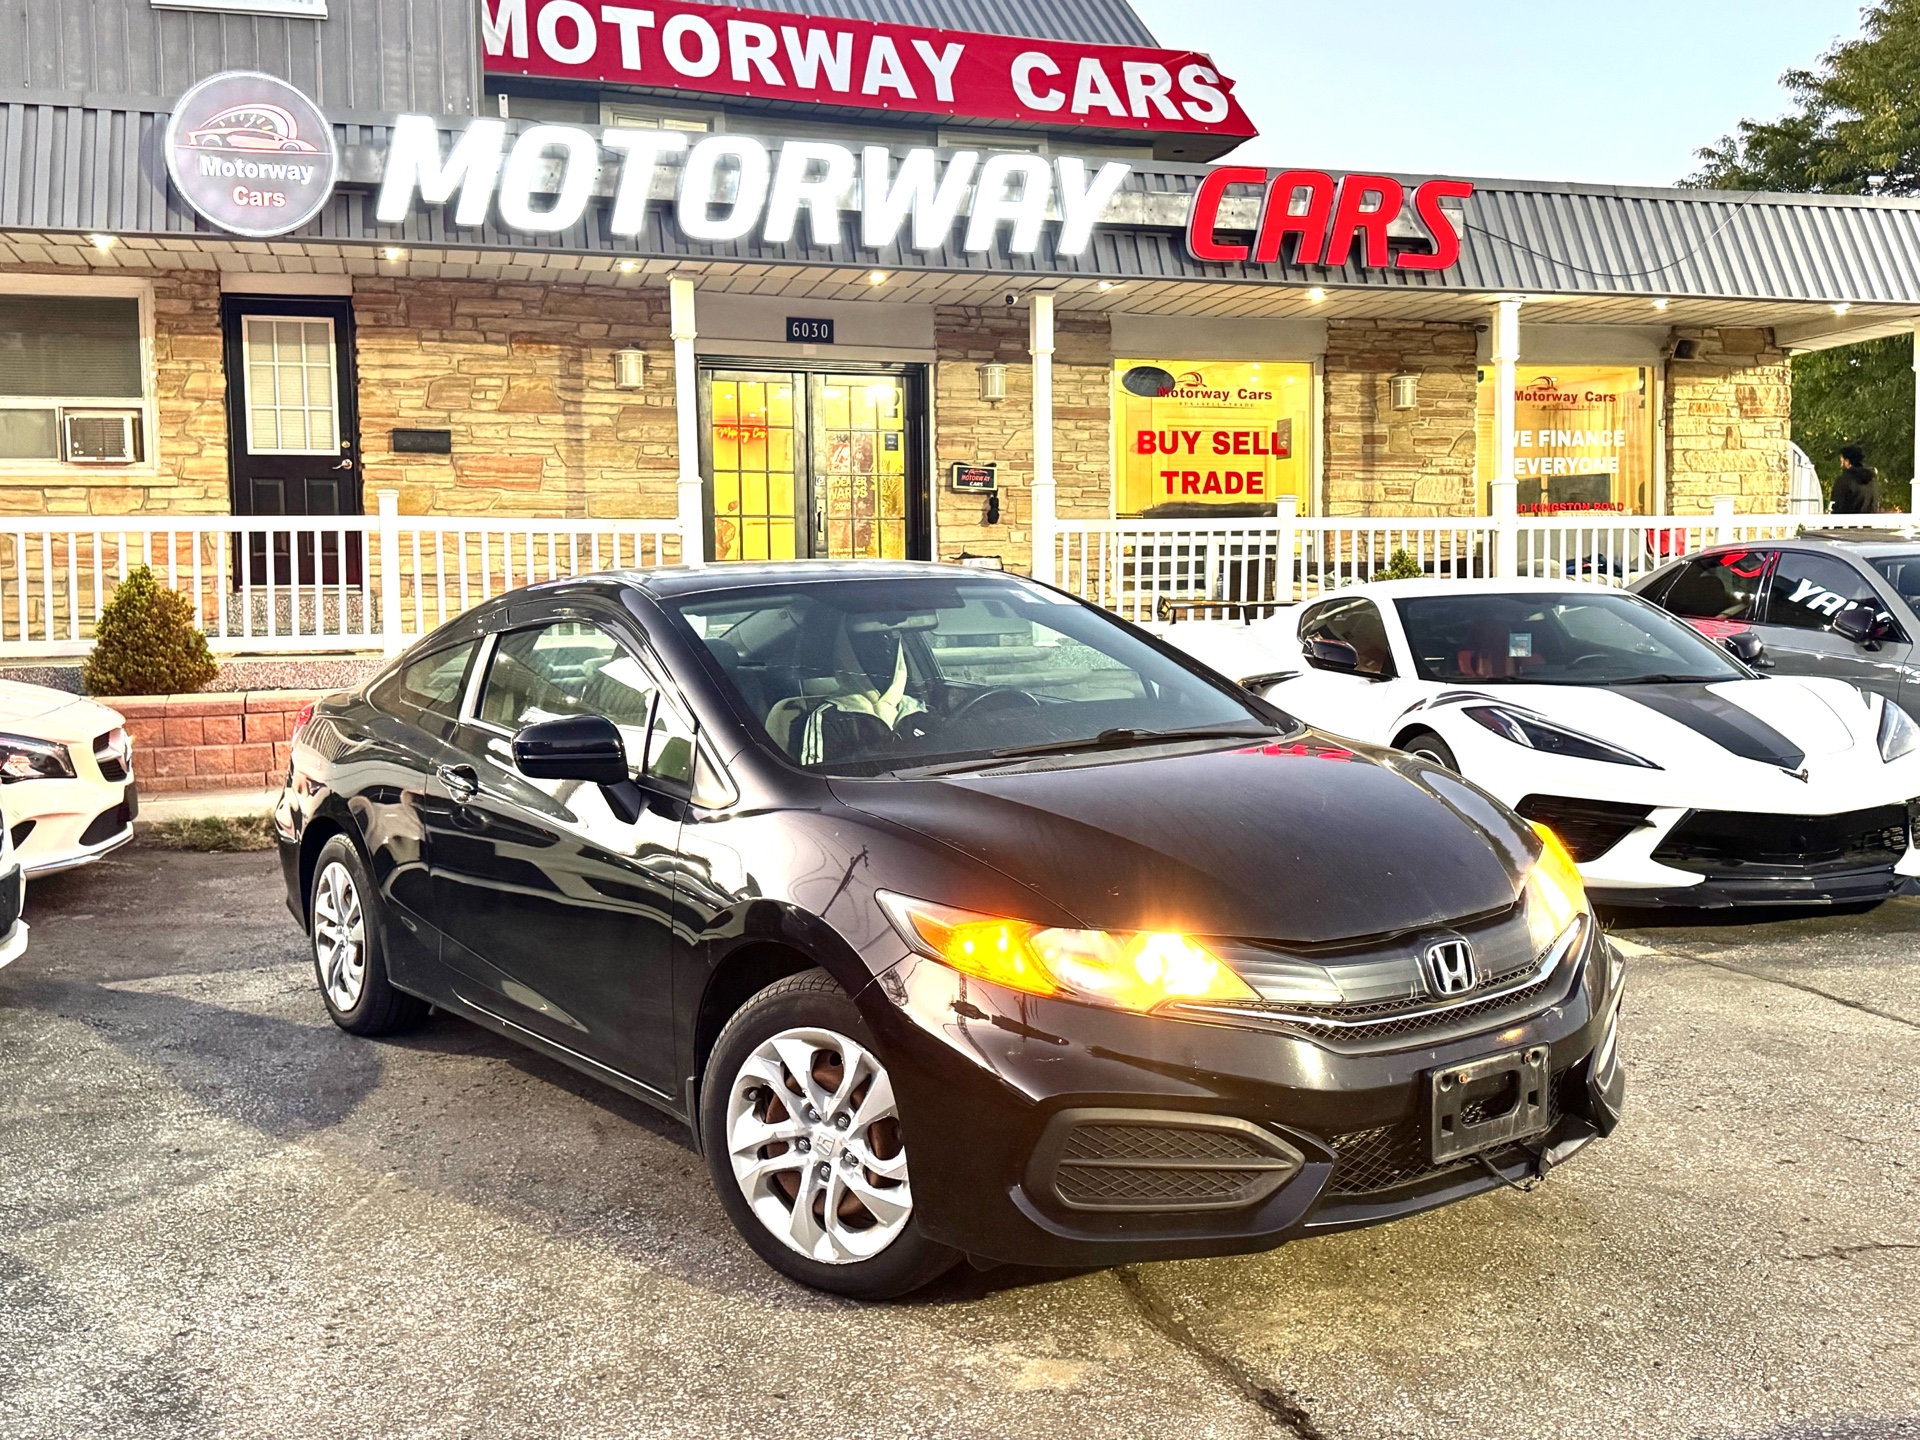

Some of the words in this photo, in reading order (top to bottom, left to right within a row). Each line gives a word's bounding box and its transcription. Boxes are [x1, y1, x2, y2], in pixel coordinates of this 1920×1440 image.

[482, 0, 965, 103] MOTORWAY
[1010, 51, 1229, 124] CARS
[200, 156, 314, 184] Motorway
[233, 186, 286, 207] Cars
[376, 114, 1132, 258] MOTORWAY
[1187, 166, 1473, 271] CARS
[792, 322, 829, 339] 6030
[1158, 386, 1230, 402] Motorway
[1237, 388, 1272, 400] Cars
[1515, 390, 1578, 404] Motorway
[1585, 391, 1617, 403] Cars
[1137, 430, 1201, 455] BUY
[1212, 431, 1288, 455] SELL
[1538, 430, 1626, 448] FINANCE
[1514, 457, 1620, 475] EVERYONE
[1160, 471, 1264, 495] TRADE
[1531, 503, 1590, 513] KINGSTON
[1594, 502, 1625, 512] ROAD
